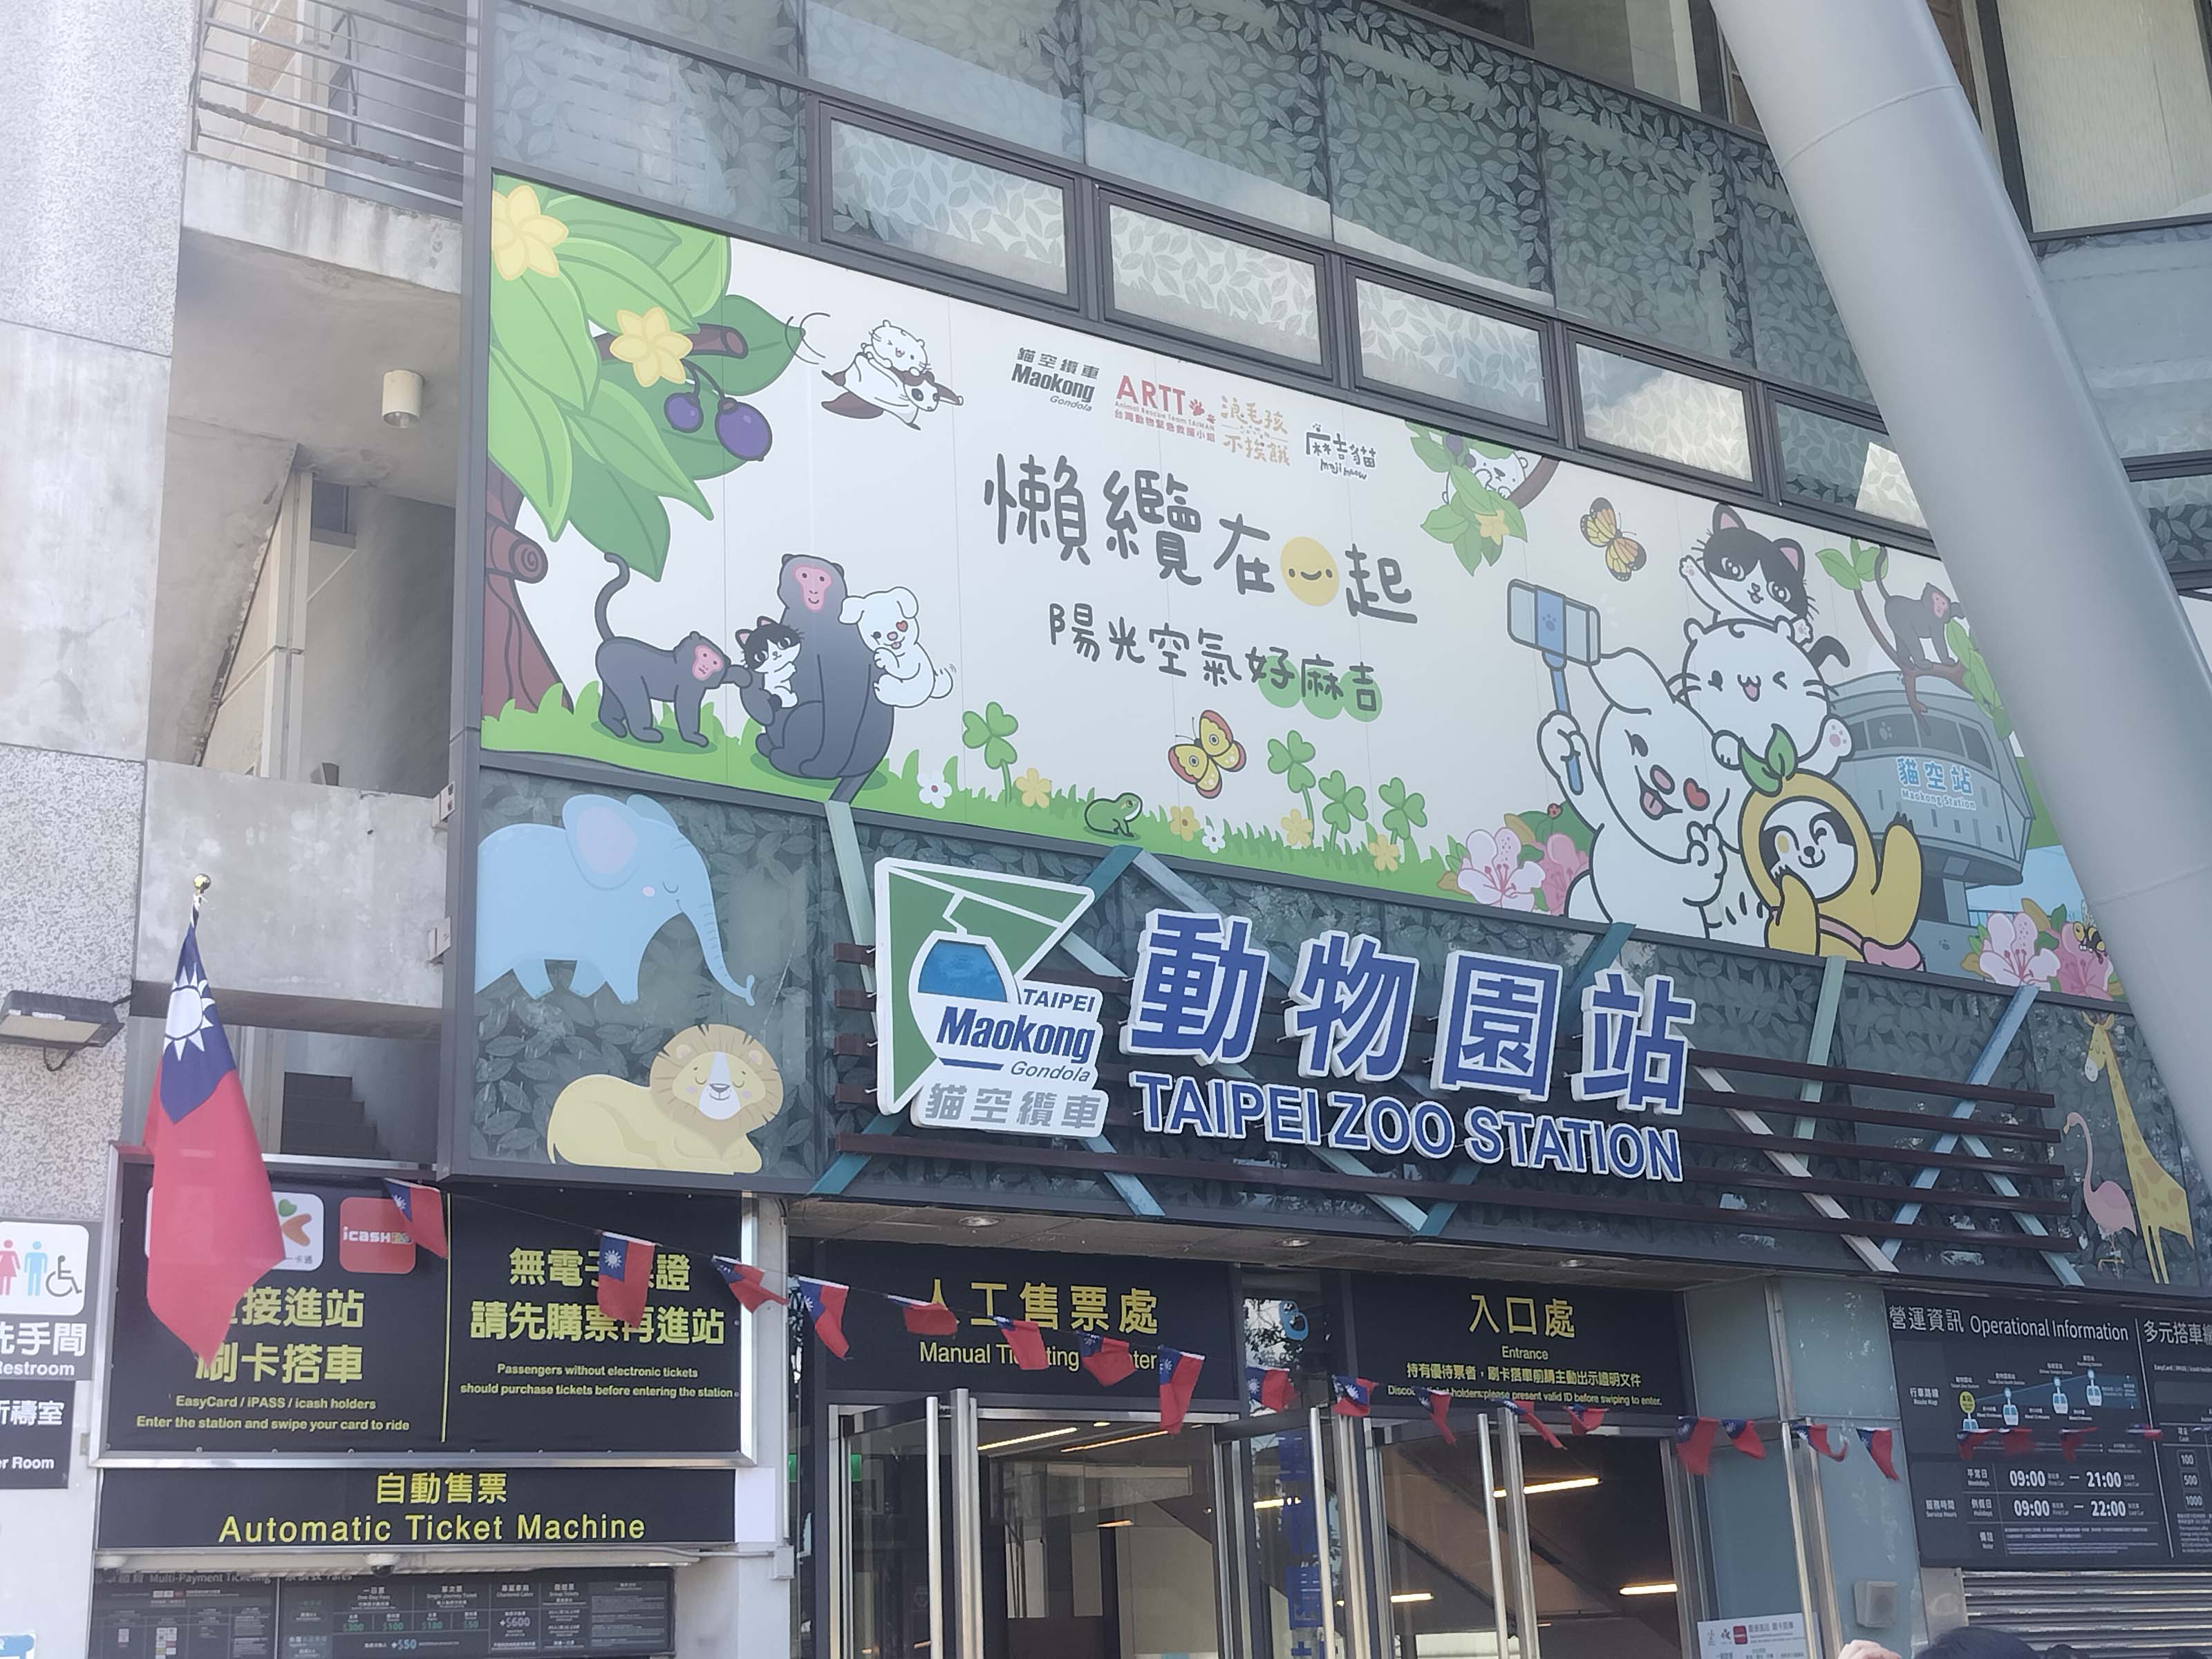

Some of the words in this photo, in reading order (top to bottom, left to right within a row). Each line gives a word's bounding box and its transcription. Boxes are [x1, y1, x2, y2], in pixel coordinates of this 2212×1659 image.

[1017, 347, 1100, 379] 貓空纜車
[1011, 364, 1095, 403] Maokong
[1116, 375, 1185, 415] ARTT
[1050, 395, 1092, 412] Gondola
[1049, 603, 1378, 712] 陽光空氣好麻吉
[1896, 757, 1972, 794] 貓空站
[1902, 789, 1942, 807] Maokong
[1944, 796, 1976, 809] Station
[1023, 988, 1095, 1013] TAIPEI
[1121, 908, 1696, 1116] 動物園站
[937, 1006, 1096, 1065] Maokong
[1010, 1060, 1091, 1082] Gondola
[924, 1083, 1103, 1130] 貓空纜車
[1130, 1072, 1320, 1146] TAIPEI
[1328, 1091, 1454, 1159] ZOO
[1465, 1106, 1683, 1181] STATION
[509, 1247, 690, 1291] 無電證
[229, 1286, 364, 1327] 接進站
[1468, 1294, 1575, 1339] 入口處
[1889, 1305, 1965, 1333] 營運資訊
[1970, 1315, 2051, 1338] Operational
[2052, 1320, 2129, 1342] Information
[920, 1342, 991, 1364] Manual
[996, 1344, 1079, 1371] Titing
[1501, 1346, 1548, 1360] Entrance
[0, 1361, 75, 1376] estroom
[497, 1364, 563, 1377] Passengers
[565, 1365, 605, 1376] without
[608, 1366, 660, 1377] electronic
[663, 1367, 697, 1378] tickets
[176, 1396, 237, 1410] EasyCard
[247, 1397, 285, 1408] iPASS
[295, 1397, 327, 1409] icash
[330, 1398, 376, 1409] holders
[460, 1383, 498, 1394] should
[501, 1385, 553, 1397] purchase
[556, 1384, 592, 1395] tickets
[594, 1385, 630, 1396] before
[632, 1386, 676, 1399] entering
[679, 1386, 695, 1396] the
[698, 1387, 733, 1398] station
[1388, 1385, 1415, 1396] Disco
[1512, 1391, 1541, 1401] present
[1544, 1391, 1562, 1402] valid
[1564, 1393, 1573, 1402] ID
[1574, 1392, 1599, 1403] before
[1600, 1395, 1630, 1406] swiping
[137, 1416, 173, 1427] Enter
[175, 1416, 195, 1427] the
[198, 1418, 241, 1429] station
[245, 1418, 268, 1429] and
[271, 1419, 307, 1432] swipe
[310, 1421, 337, 1432] your
[342, 1419, 368, 1430] card
[371, 1420, 383, 1430] to
[386, 1420, 410, 1431] ride
[12, 1456, 55, 1470] Room
[2181, 1454, 2194, 1465] 100
[377, 1472, 507, 1504] 自動售票
[2009, 1470, 2046, 1487] 09:00
[2086, 1471, 2122, 1488] 21:00
[2184, 1474, 2198, 1485] 500
[2014, 1500, 2050, 1517] 09:00
[2091, 1500, 2126, 1517] 22:00
[2186, 1495, 2203, 1506] 1000
[218, 1515, 391, 1543] Automatic
[405, 1514, 503, 1541] Ticket
[518, 1513, 646, 1540] Machine
